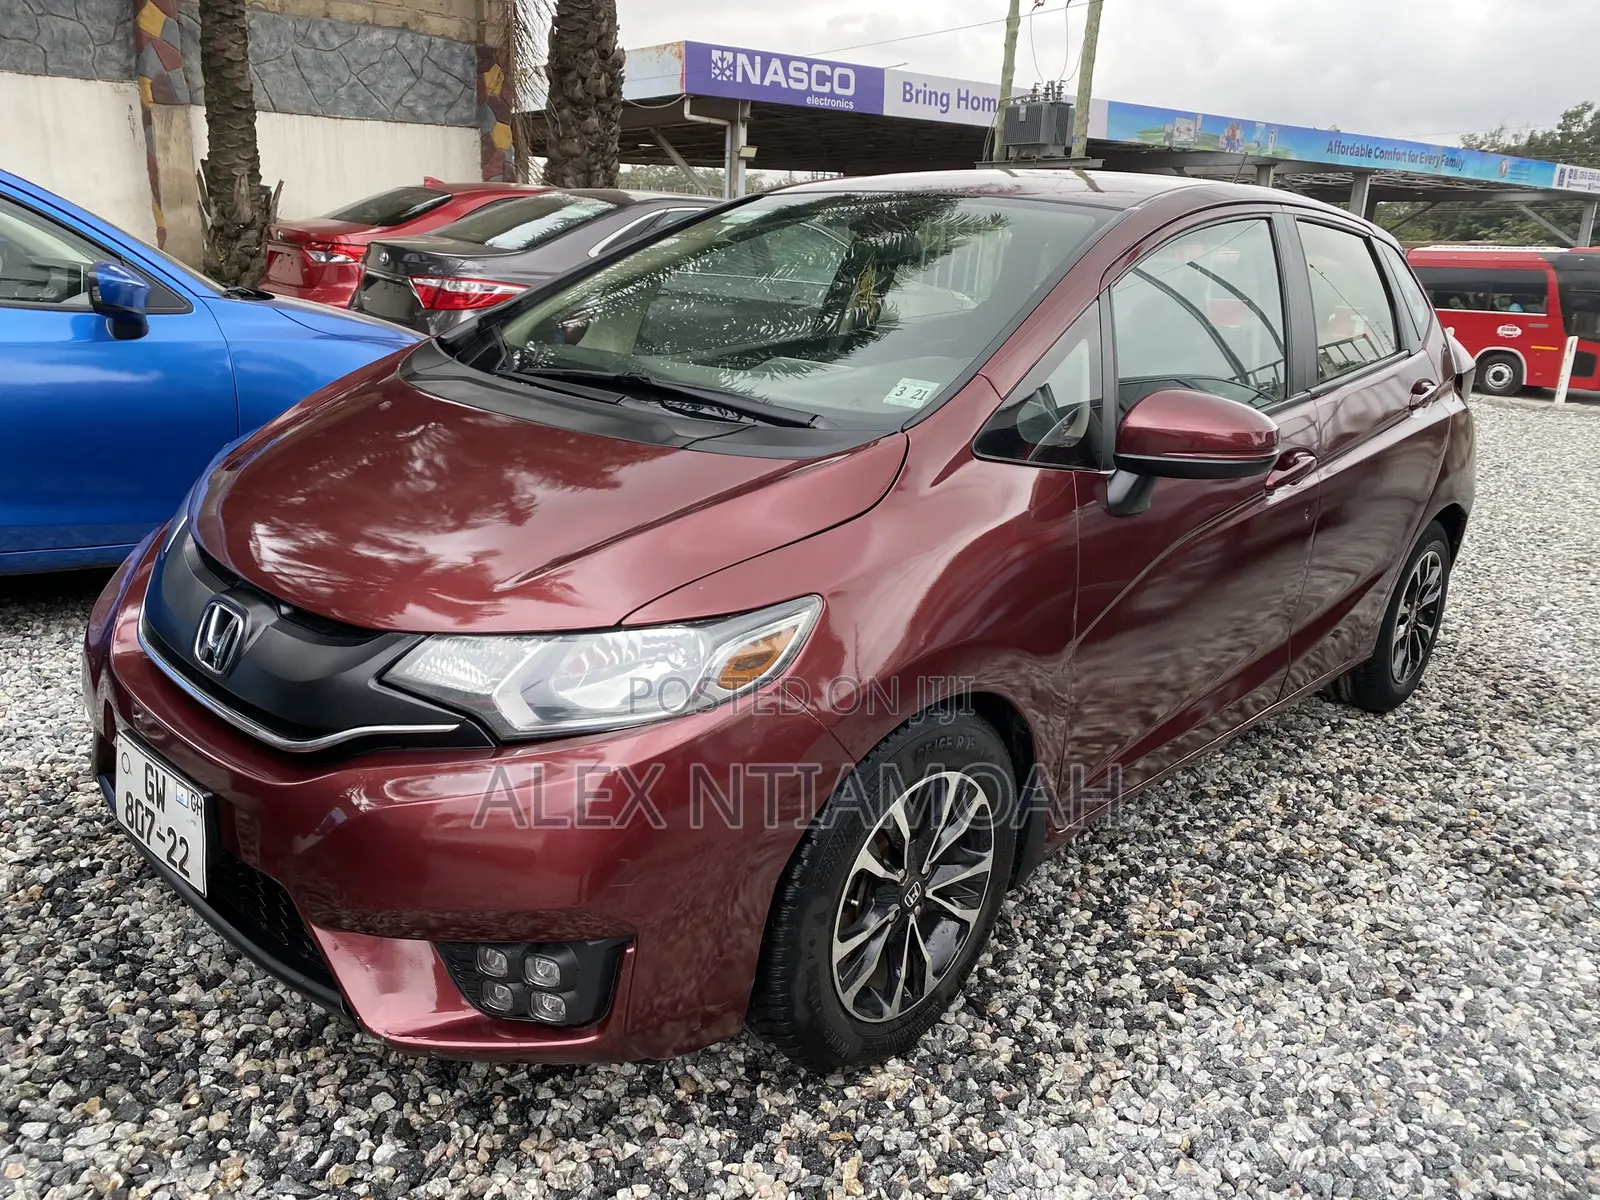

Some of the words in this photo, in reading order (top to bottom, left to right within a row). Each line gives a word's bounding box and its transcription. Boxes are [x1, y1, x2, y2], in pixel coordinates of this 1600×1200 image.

[736, 53, 856, 96] NASCO
[806, 95, 854, 109] electronics
[902, 81, 950, 114] Bring
[957, 88, 998, 113] Hom
[1326, 140, 1373, 159] Affordable
[1374, 146, 1407, 162] Comfort
[1408, 150, 1419, 164] for
[1420, 152, 1441, 169] Every
[1440, 154, 1466, 171] Family
[895, 386, 907, 397] 3
[910, 389, 929, 401] 21
[144, 762, 166, 813] GW
[125, 791, 190, 878] 807-22
